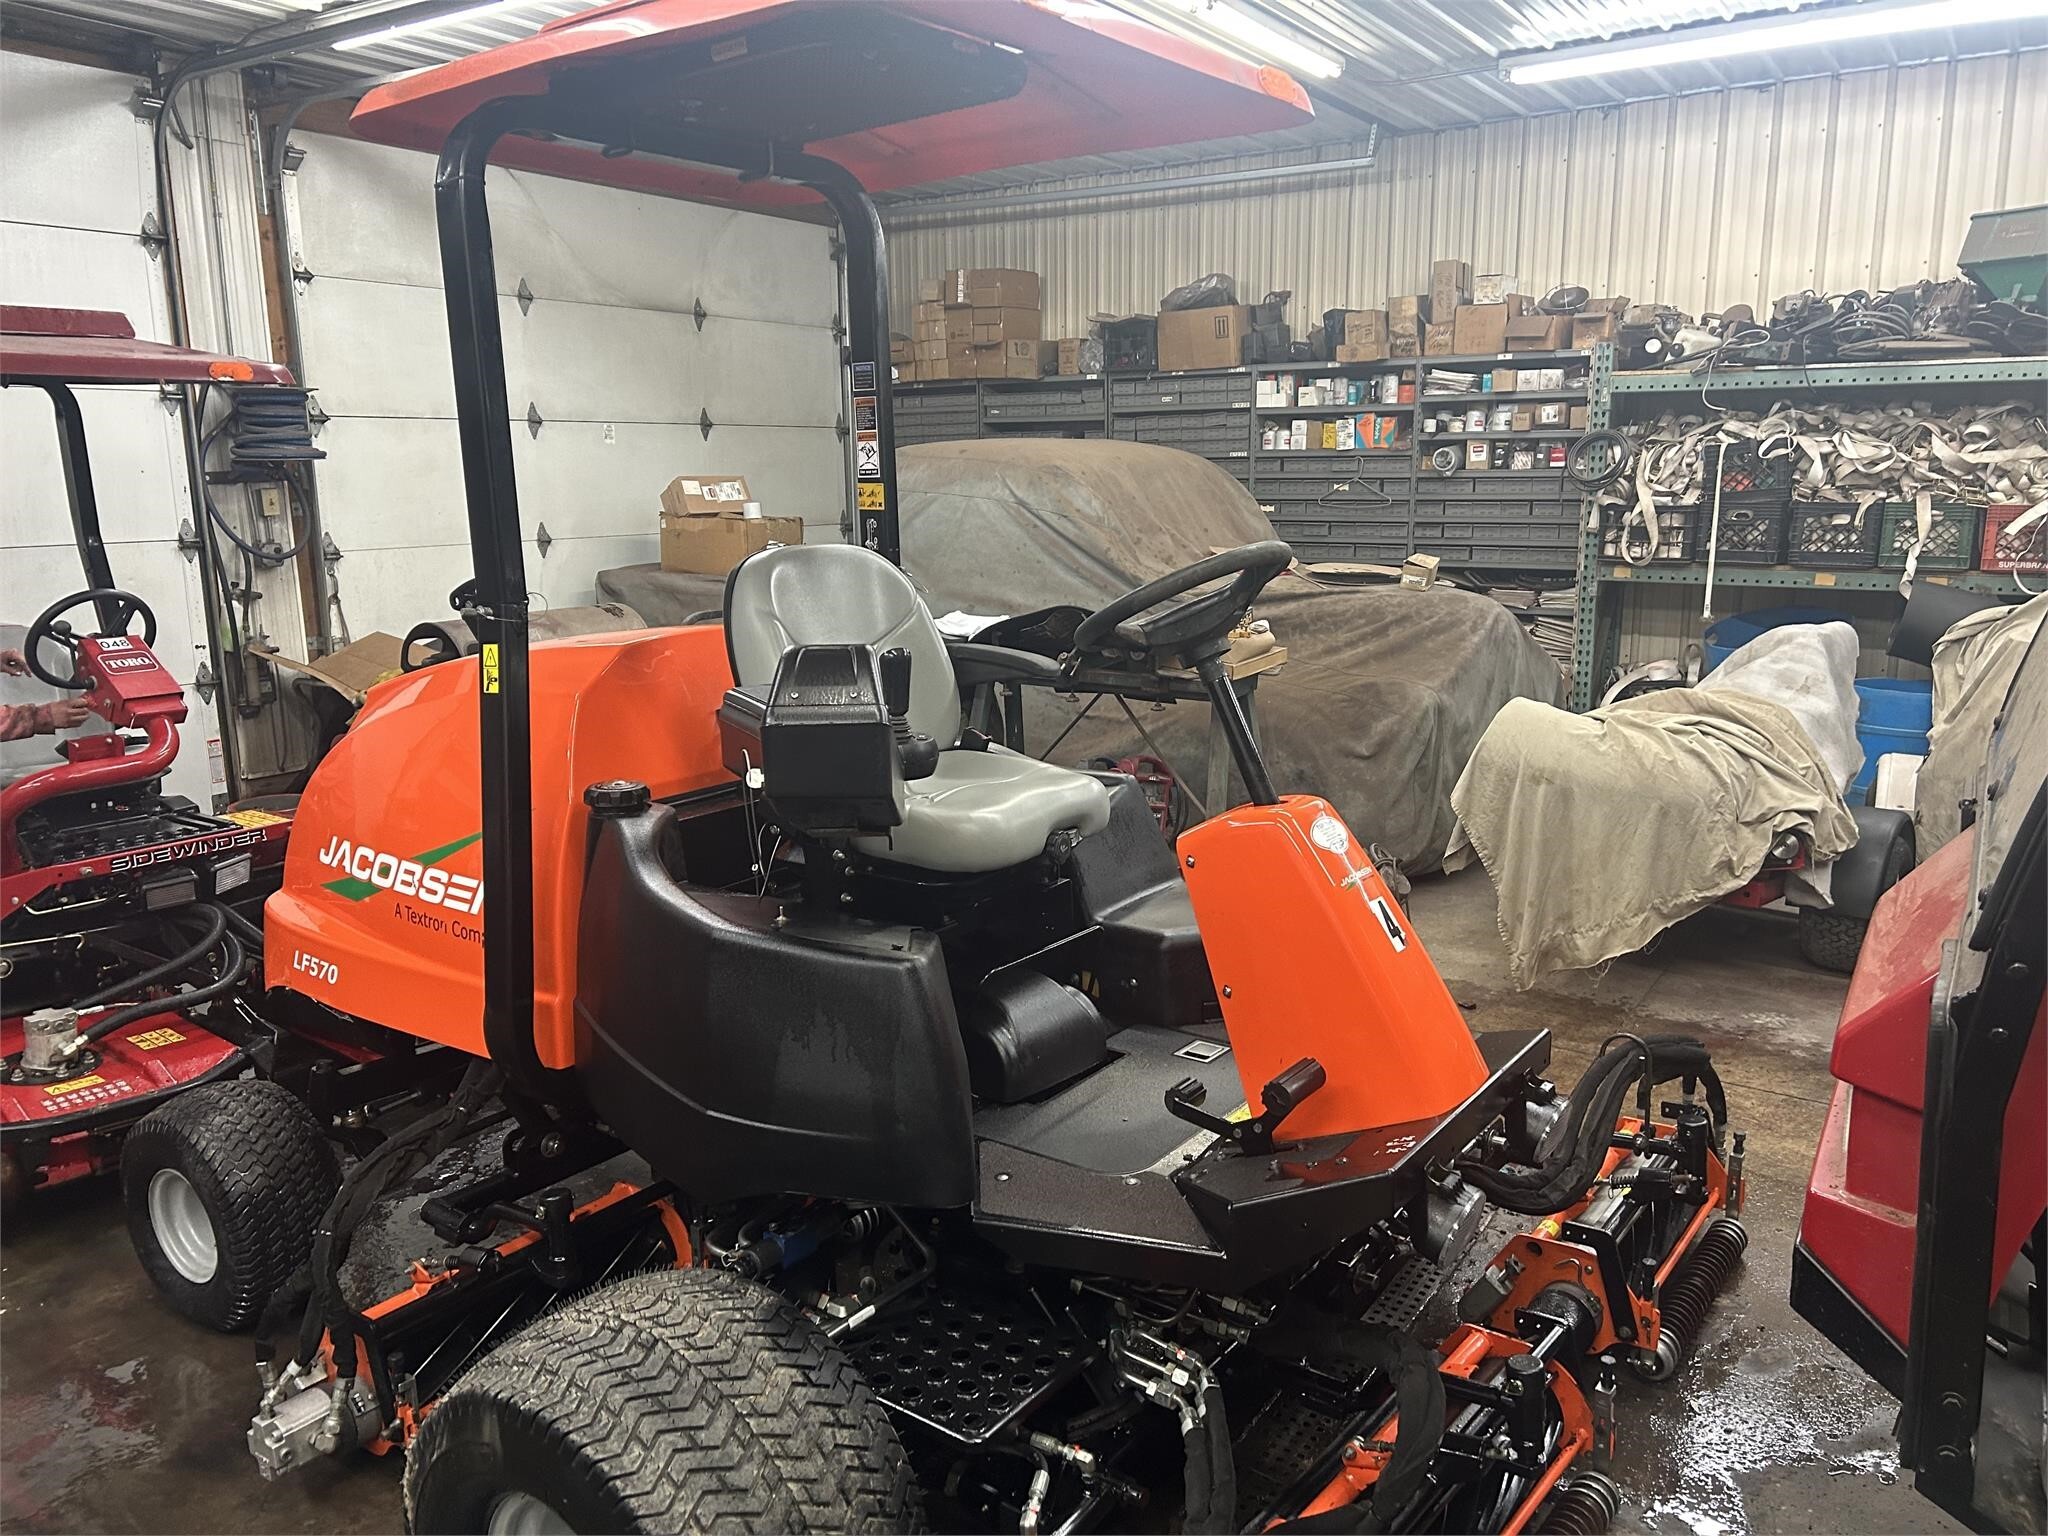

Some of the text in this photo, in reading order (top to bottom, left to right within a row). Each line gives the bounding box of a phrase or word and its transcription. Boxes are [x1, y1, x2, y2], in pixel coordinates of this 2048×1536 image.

[100, 640, 130, 649] 048
[105, 656, 152, 669] TORO
[111, 829, 268, 873] SIDEWINDER
[394, 902, 485, 948] A Textron Com
[1377, 900, 1405, 947] 4
[293, 950, 338, 984] LF570
